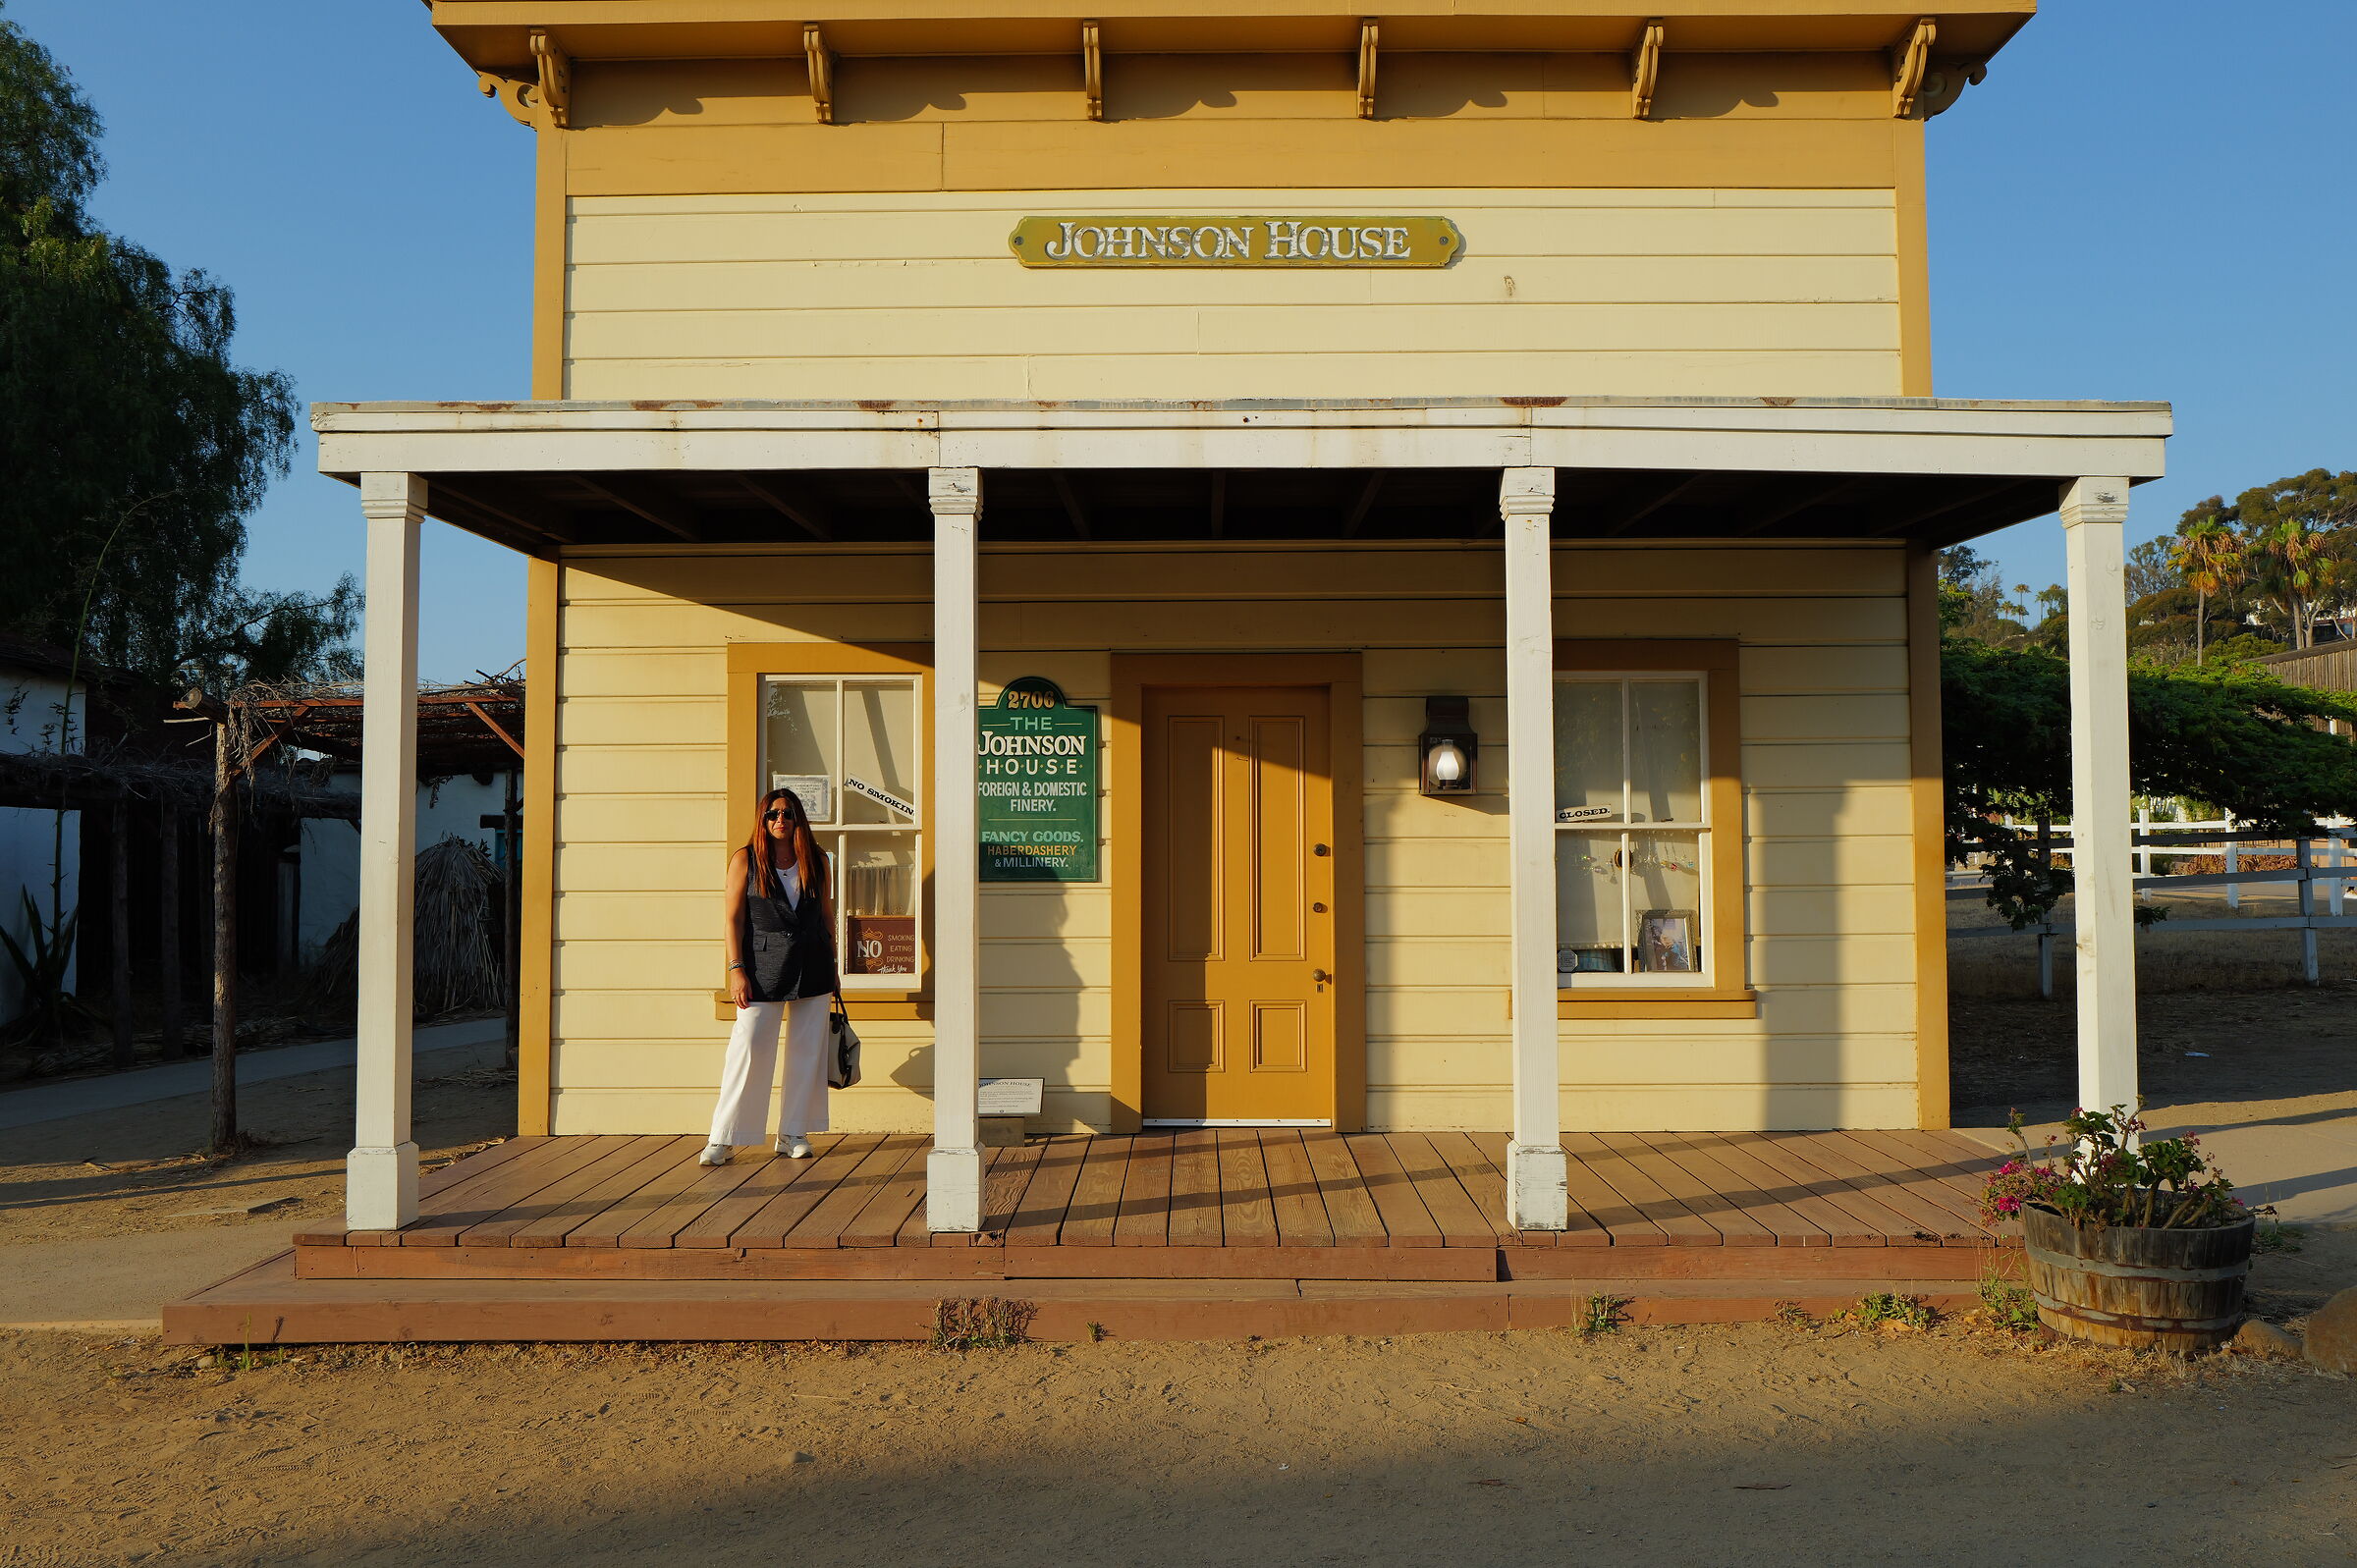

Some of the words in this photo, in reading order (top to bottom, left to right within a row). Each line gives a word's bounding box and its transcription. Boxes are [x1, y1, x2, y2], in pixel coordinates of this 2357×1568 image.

[1045, 221, 1256, 261] JOHNSON
[1263, 220, 1412, 261] HOUSE
[1008, 690, 1056, 709] 2706
[1010, 716, 1054, 730] THE
[978, 730, 1087, 756] JOHNSON
[978, 782, 1020, 796] FOREIGN
[1022, 782, 1032, 796] &
[1034, 782, 1087, 796] DOMESTIC
[849, 779, 865, 790] NO
[867, 788, 914, 816] SMOKIN
[1011, 798, 1057, 812] FINERY.
[1559, 808, 1611, 819] CLOSED.
[982, 831, 1029, 842] FANCY
[1032, 831, 1084, 843] GOODS.
[987, 844, 1077, 856] HABERDASHERY
[1003, 857, 1069, 868] MILLINERY.
[856, 940, 883, 958] NO
